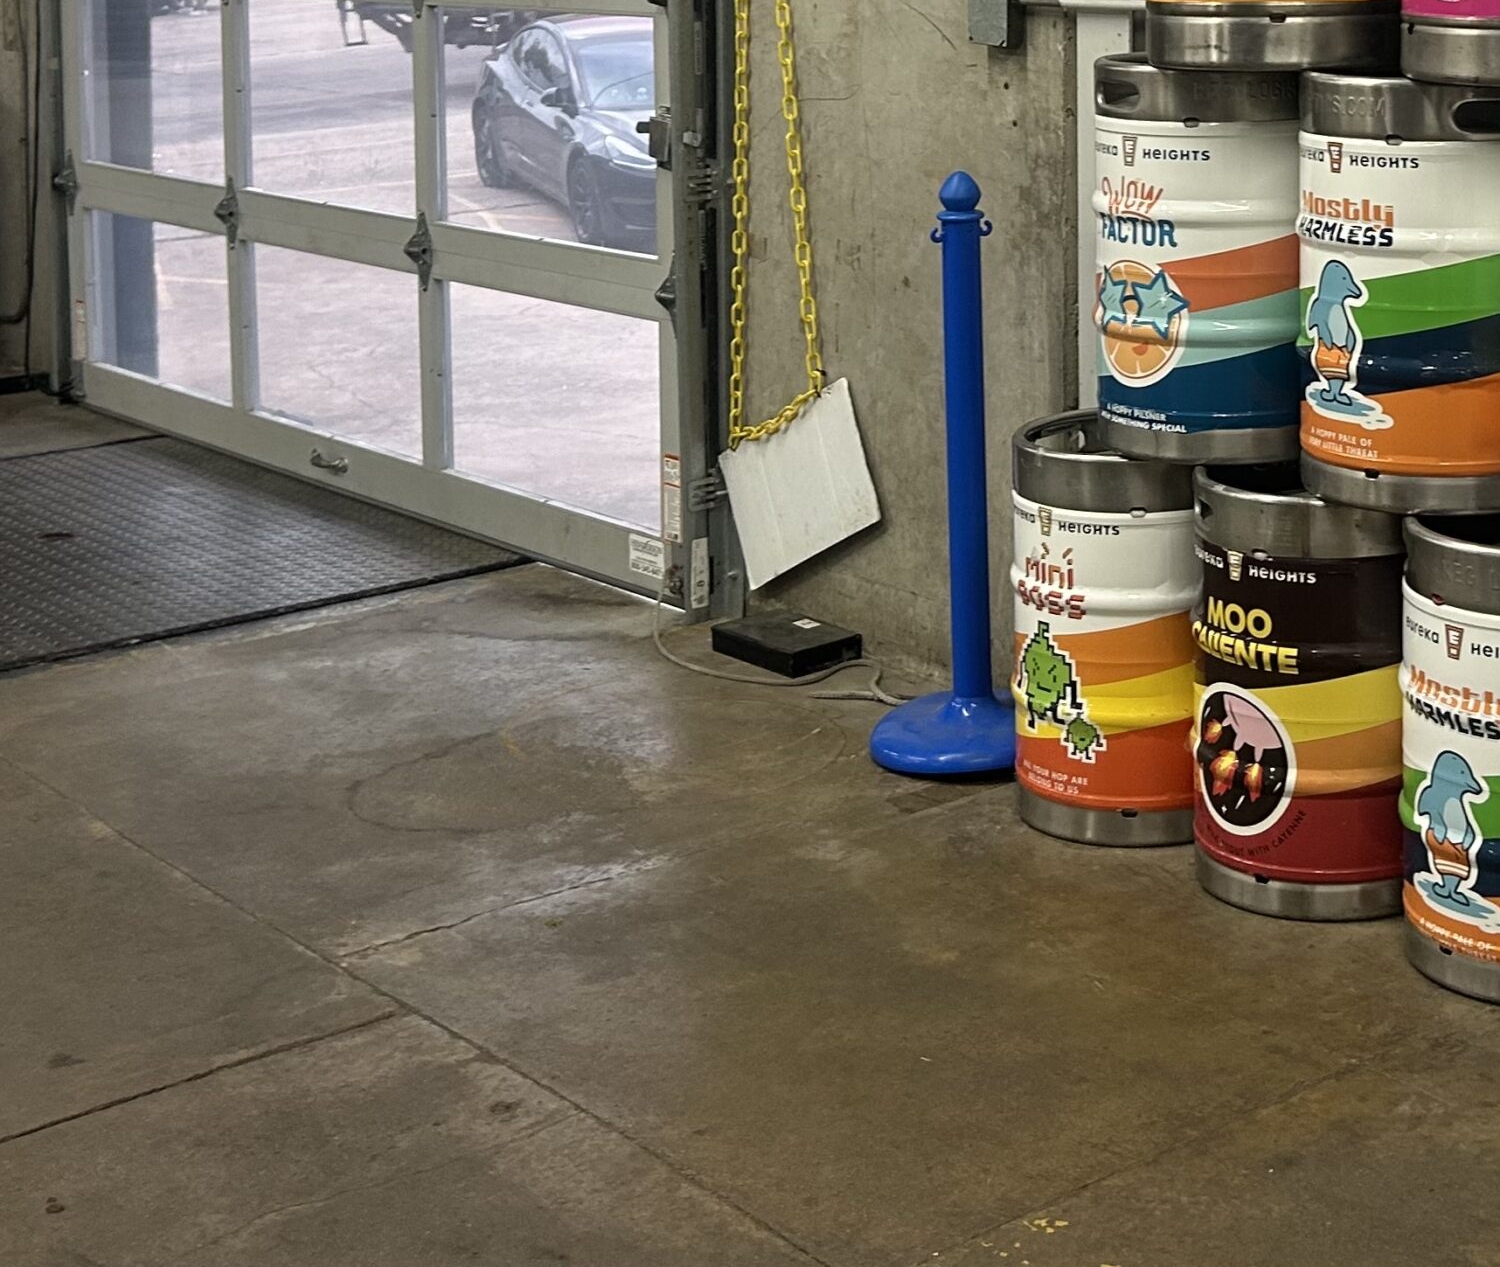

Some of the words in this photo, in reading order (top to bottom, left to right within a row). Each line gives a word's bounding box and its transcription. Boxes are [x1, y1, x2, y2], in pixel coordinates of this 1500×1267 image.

[1303, 189, 1394, 230] Mostly
[1099, 212, 1178, 248] FACTOR
[1300, 216, 1394, 247] HARMLESS
[1151, 422, 1187, 434] SPECIAL
[1360, 438, 1373, 447] OF
[1018, 583, 1087, 620] BOSS
[1207, 595, 1273, 639] MOO
[1192, 621, 1299, 675] CALIENTE
